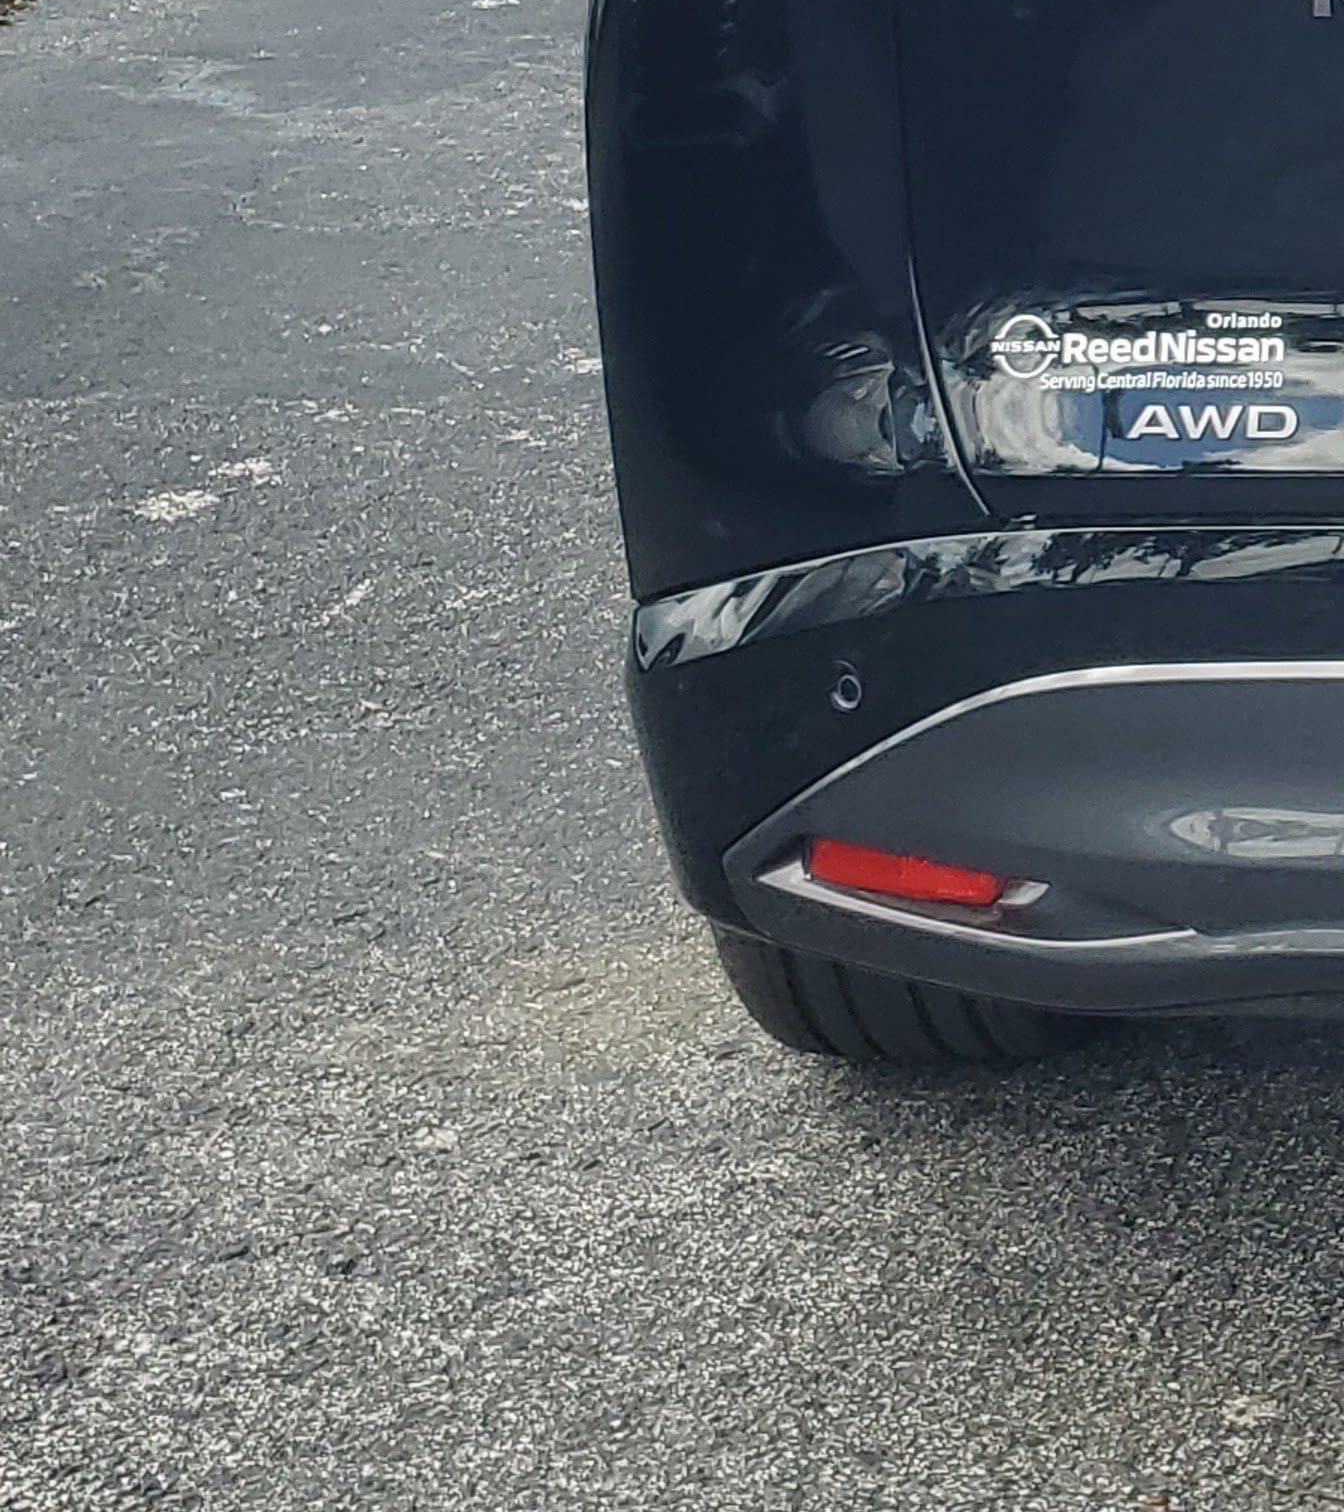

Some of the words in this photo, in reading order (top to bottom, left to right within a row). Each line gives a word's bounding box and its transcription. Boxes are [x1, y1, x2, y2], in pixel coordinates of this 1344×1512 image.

[1206, 312, 1282, 329] Orlando
[991, 340, 1061, 353] NISSAN
[1041, 373, 1096, 393] Serving
[1098, 373, 1151, 390] Central
[1152, 372, 1206, 390] Florida
[1247, 372, 1283, 389] 1950
[1127, 404, 1299, 440] AWD
